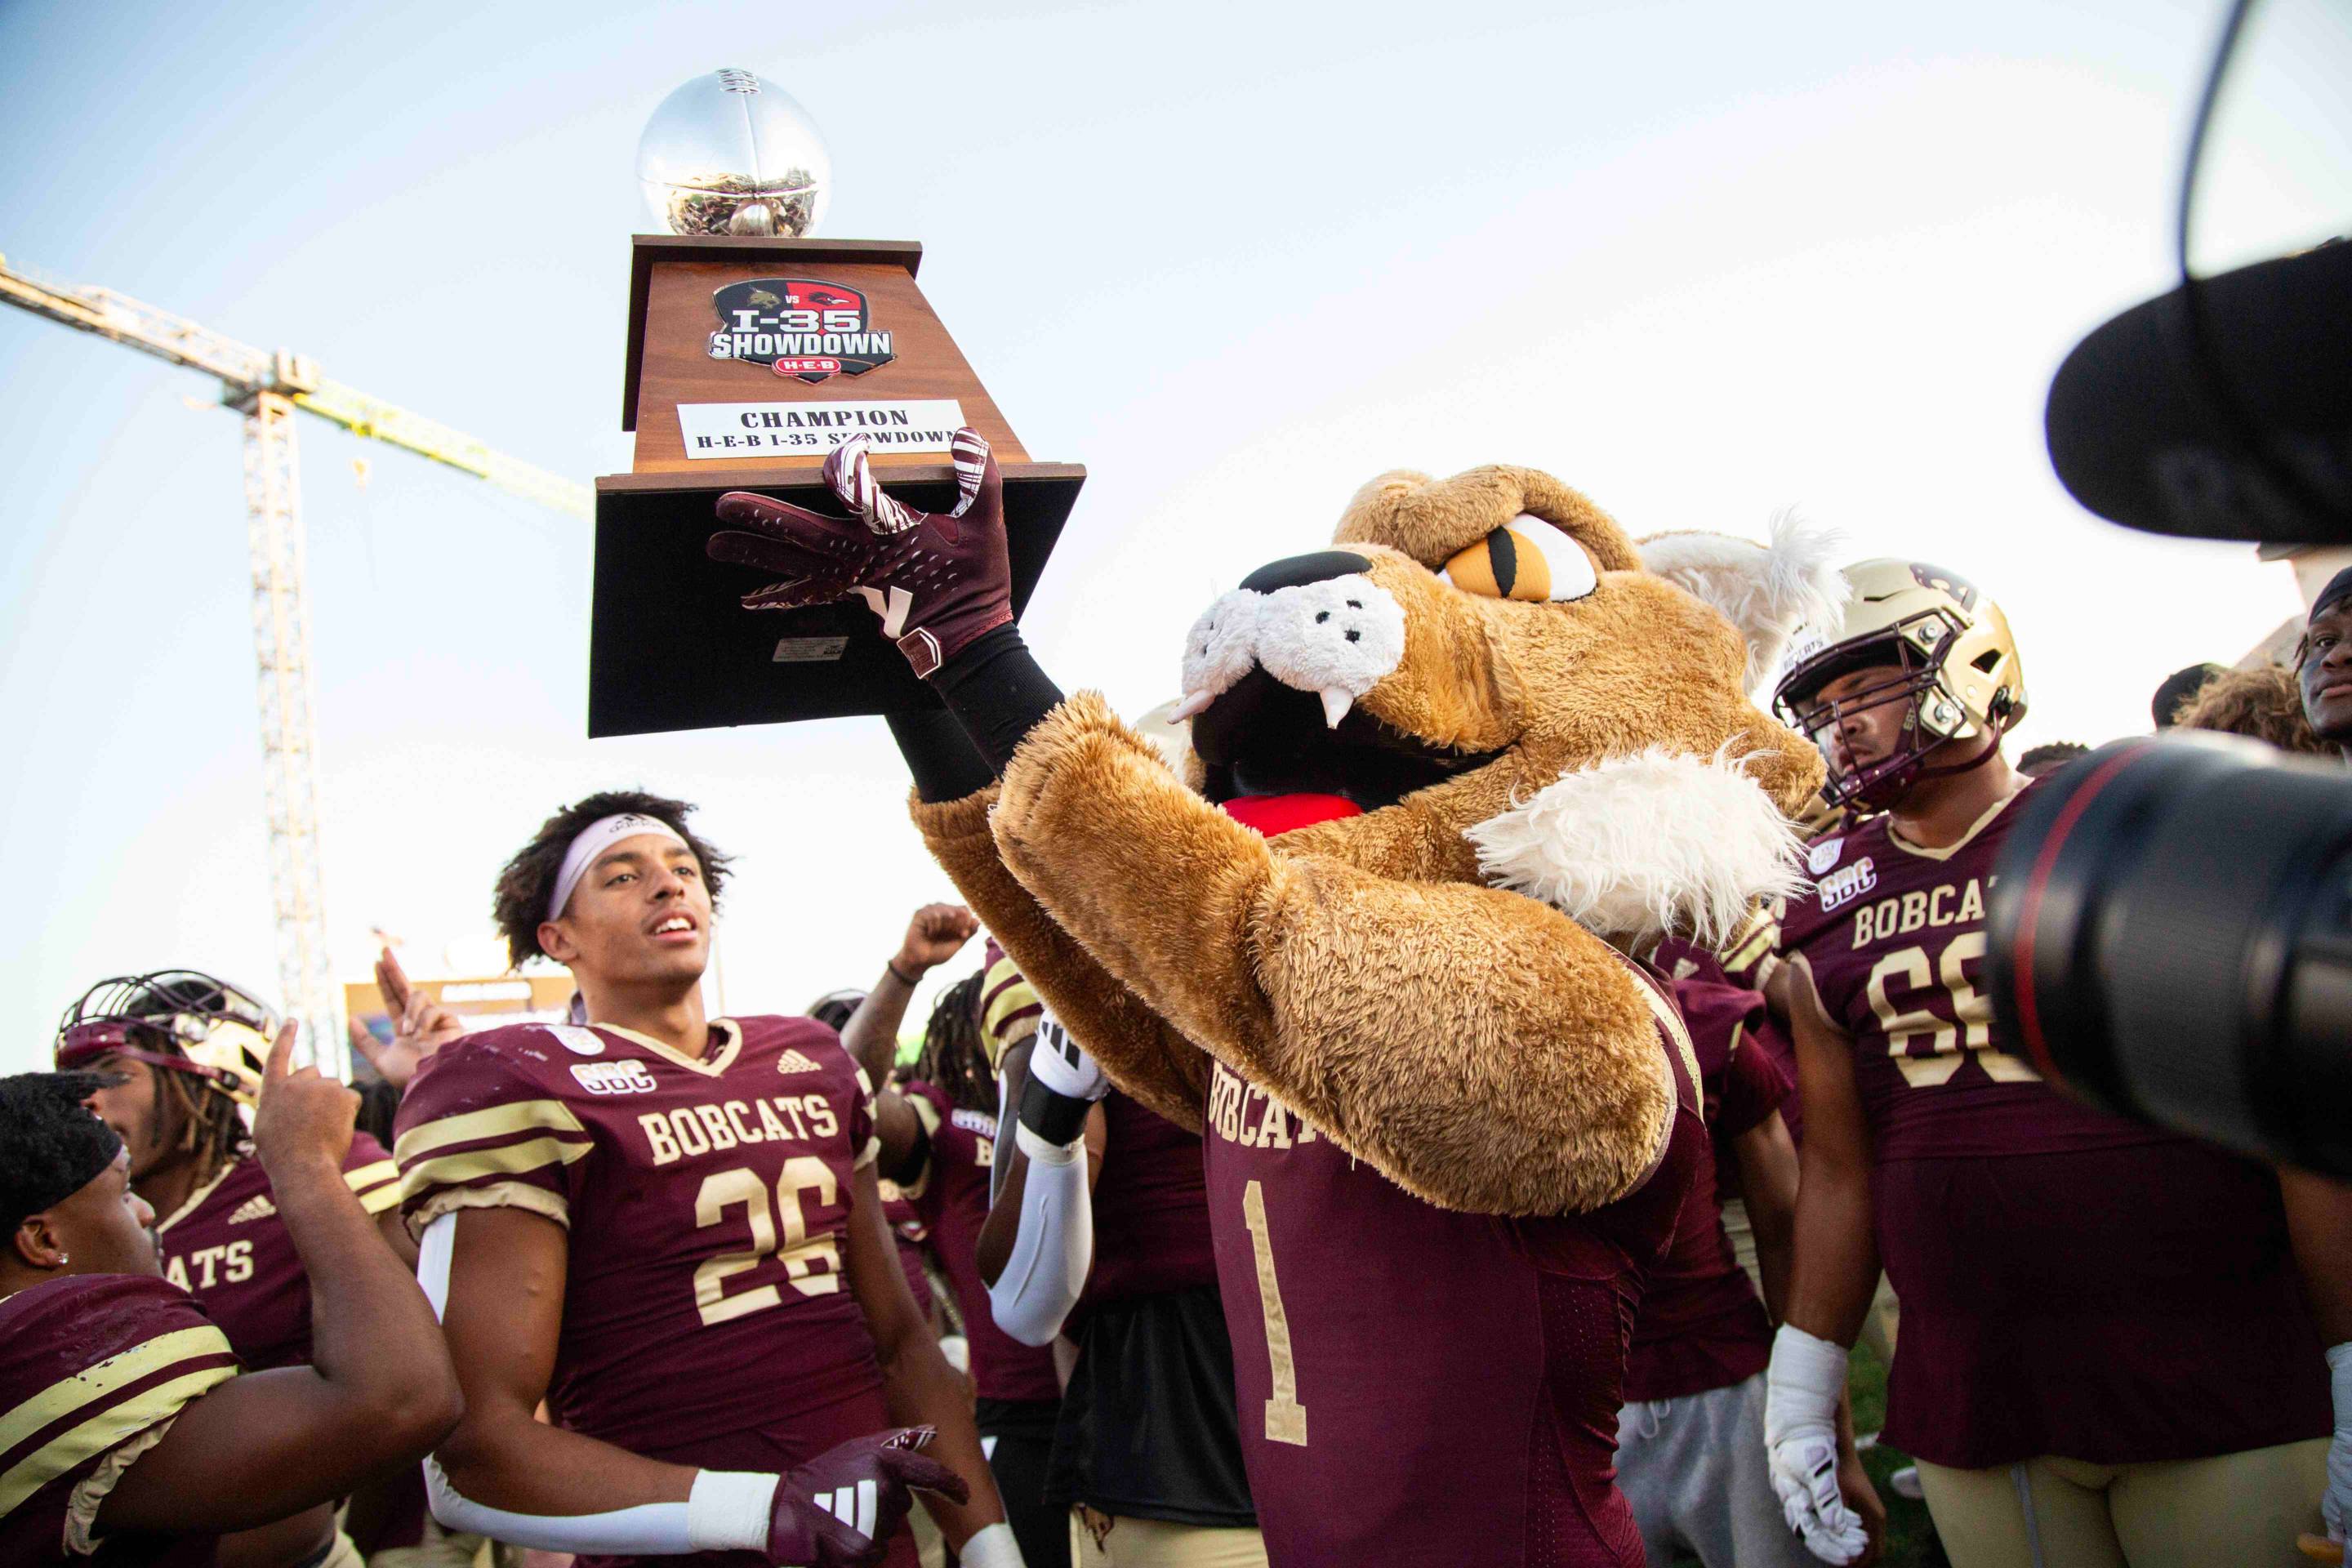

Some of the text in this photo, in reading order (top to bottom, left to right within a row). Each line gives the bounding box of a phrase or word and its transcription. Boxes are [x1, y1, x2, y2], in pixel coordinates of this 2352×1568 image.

[785, 295, 800, 305] VS
[732, 310, 862, 332] I-35
[712, 332, 891, 357] SHOWDOWN
[740, 409, 910, 429] CHAMPION
[696, 434, 761, 448] H-E-B
[770, 433, 818, 447] I-35
[1818, 856, 1878, 912] SBC
[1851, 875, 1998, 951] BOBCA
[569, 1059, 657, 1095] SBC
[638, 1094, 840, 1166] BOBCATS
[693, 1156, 842, 1326] 26
[1242, 1180, 1307, 1446] 1
